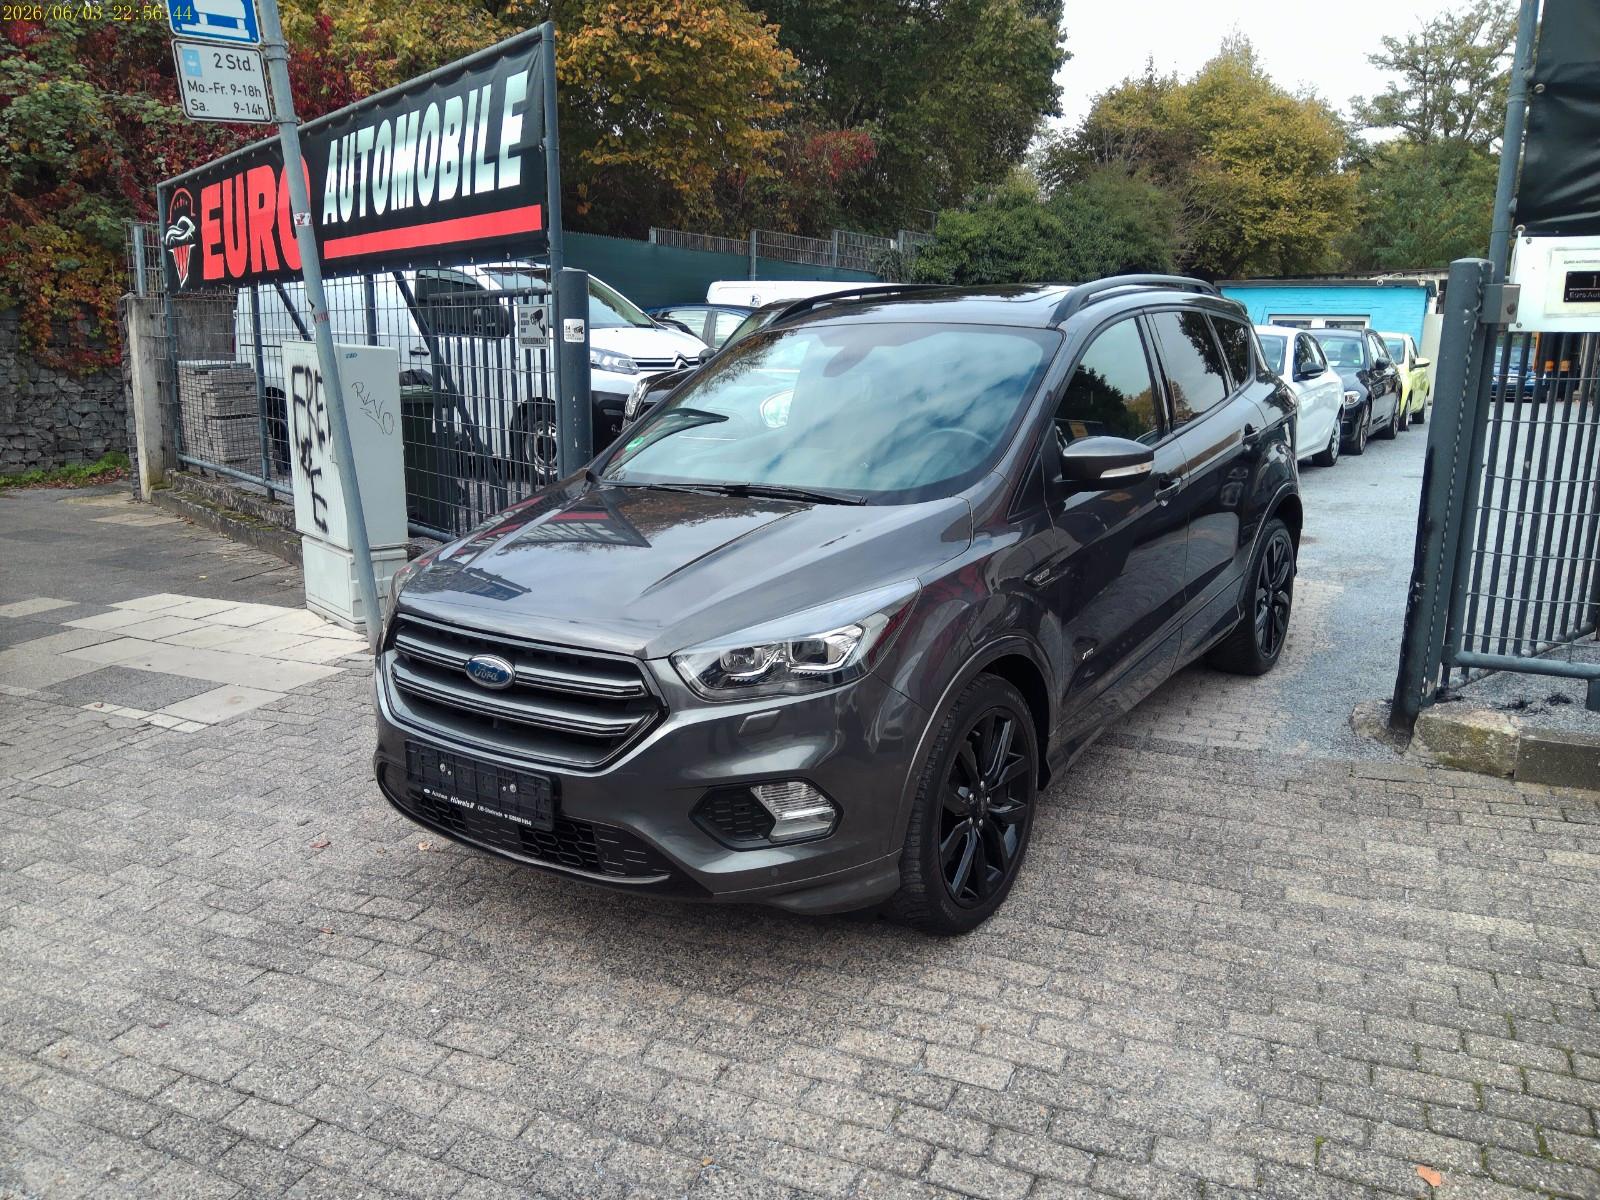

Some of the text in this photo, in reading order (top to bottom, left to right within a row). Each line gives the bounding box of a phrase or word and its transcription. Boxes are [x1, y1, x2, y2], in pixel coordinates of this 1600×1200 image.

[213, 52, 256, 72] 2 Std.
[187, 80, 262, 98] Mo.-Fr. 9-18h
[190, 98, 265, 116] Sa. 9-14h
[322, 70, 528, 225] AUTOMOBILE
